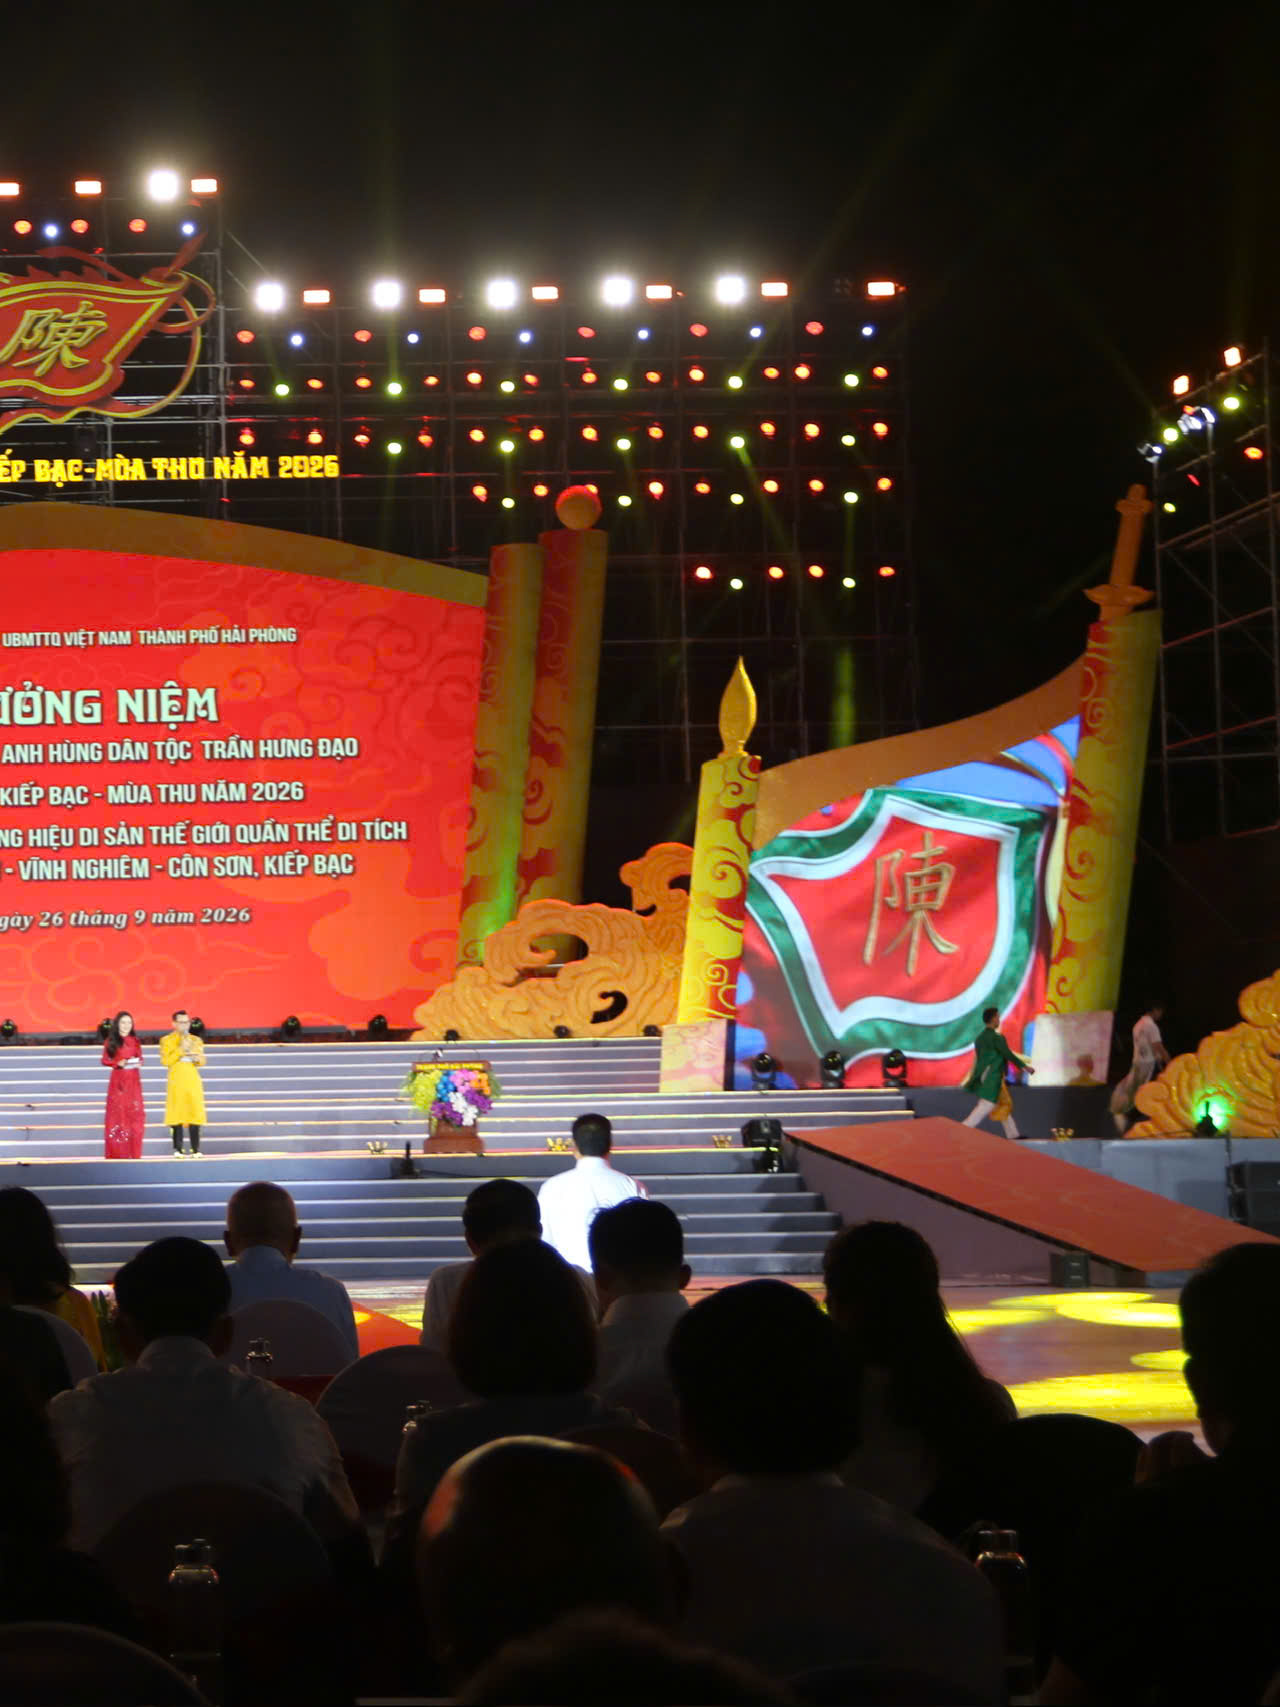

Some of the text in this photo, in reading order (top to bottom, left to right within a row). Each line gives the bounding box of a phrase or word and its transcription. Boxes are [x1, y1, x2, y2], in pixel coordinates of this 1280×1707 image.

[213, 450, 269, 479] NĂM
[278, 455, 340, 478] 2026
[2, 631, 61, 647] UBMTTQ
[63, 628, 95, 649] VIỆT
[98, 630, 131, 646] NAM
[138, 627, 187, 645] THÀNH
[189, 625, 220, 645] PHỐ
[222, 624, 246, 644] HẢI
[249, 627, 297, 643] PHÒNG
[117, 680, 219, 731] NIỆM
[1, 744, 43, 764] ANH
[48, 740, 103, 763] HÙNG
[108, 738, 148, 762] DÂN
[153, 738, 192, 764] TỘC
[201, 735, 254, 759] TRẦN
[259, 739, 313, 758] HƯNG
[317, 738, 358, 761] ĐẠO
[0, 781, 44, 806] KIẾP
[48, 785, 89, 809] BẠC
[107, 781, 152, 804] MÙA
[156, 783, 196, 803] THU
[201, 780, 247, 802] NĂM
[251, 781, 304, 801] 2026
[28, 825, 74, 851] HIỆU
[79, 827, 98, 846] DI
[104, 820, 143, 846] SẢN
[148, 820, 191, 845] THẾ
[192, 822, 230, 844] GIỚI
[235, 818, 289, 843] QUẦN
[294, 814, 336, 842] THỂ
[337, 822, 357, 841] DI
[361, 818, 407, 840] TÍCH
[18, 857, 67, 880] VĨNH
[72, 855, 149, 879] NGHIÊM
[168, 854, 209, 878] CÔN
[213, 856, 258, 878] SƠN,
[264, 849, 309, 875] KIẾP
[313, 853, 353, 878] BẠC
[863, 830, 959, 976] 陳
[38, 911, 63, 927] 26
[69, 909, 128, 929] tháng
[133, 909, 146, 924] 9
[151, 909, 195, 924] năm
[200, 908, 251, 923] 2026
